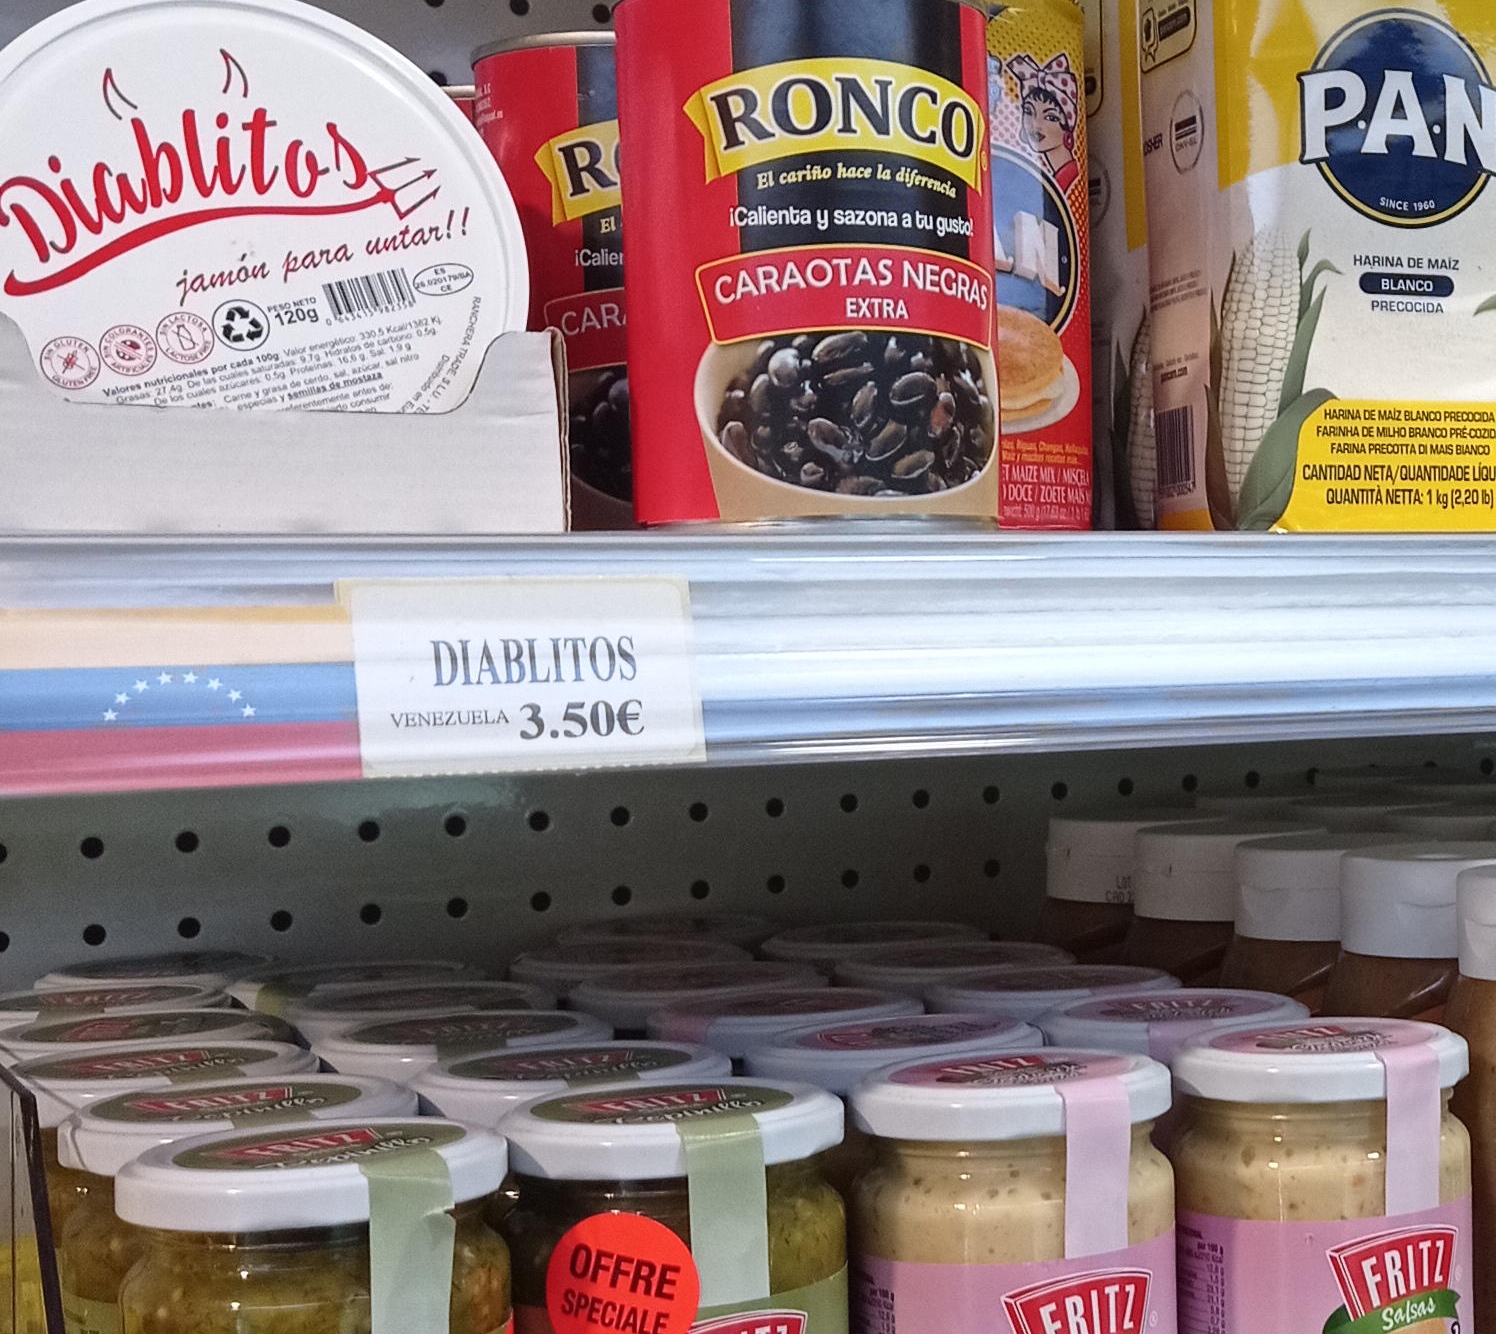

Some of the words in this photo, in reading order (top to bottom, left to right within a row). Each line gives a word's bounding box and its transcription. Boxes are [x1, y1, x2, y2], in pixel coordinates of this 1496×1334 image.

[709, 76, 976, 160] RONCO
[0, 108, 368, 263] Diablitos
[817, 211, 829, 230] y
[833, 209, 898, 227] sazona
[902, 214, 912, 228] a
[915, 214, 934, 230] tu
[936, 217, 974, 237] gusto!
[175, 253, 269, 305] jamón
[282, 241, 354, 283] para
[365, 207, 470, 256] untar!!
[1353, 254, 1404, 269] HARINA
[1407, 255, 1423, 269] DE
[714, 257, 893, 305] CARAOTAS
[902, 261, 988, 311] NEGRAS
[1381, 278, 1434, 292] BLANCO
[274, 307, 320, 328] 120g
[846, 298, 909, 320] EXTRA
[1371, 300, 1444, 315] PRECOCIDA
[430, 635, 637, 687] DIABLITOS
[390, 709, 510, 728] VENEZUELA
[519, 698, 645, 740] 3.50€
[569, 1243, 680, 1301] OFFRE
[1361, 1240, 1444, 1307] FRITZ
[1382, 1297, 1435, 1330] Salsas
